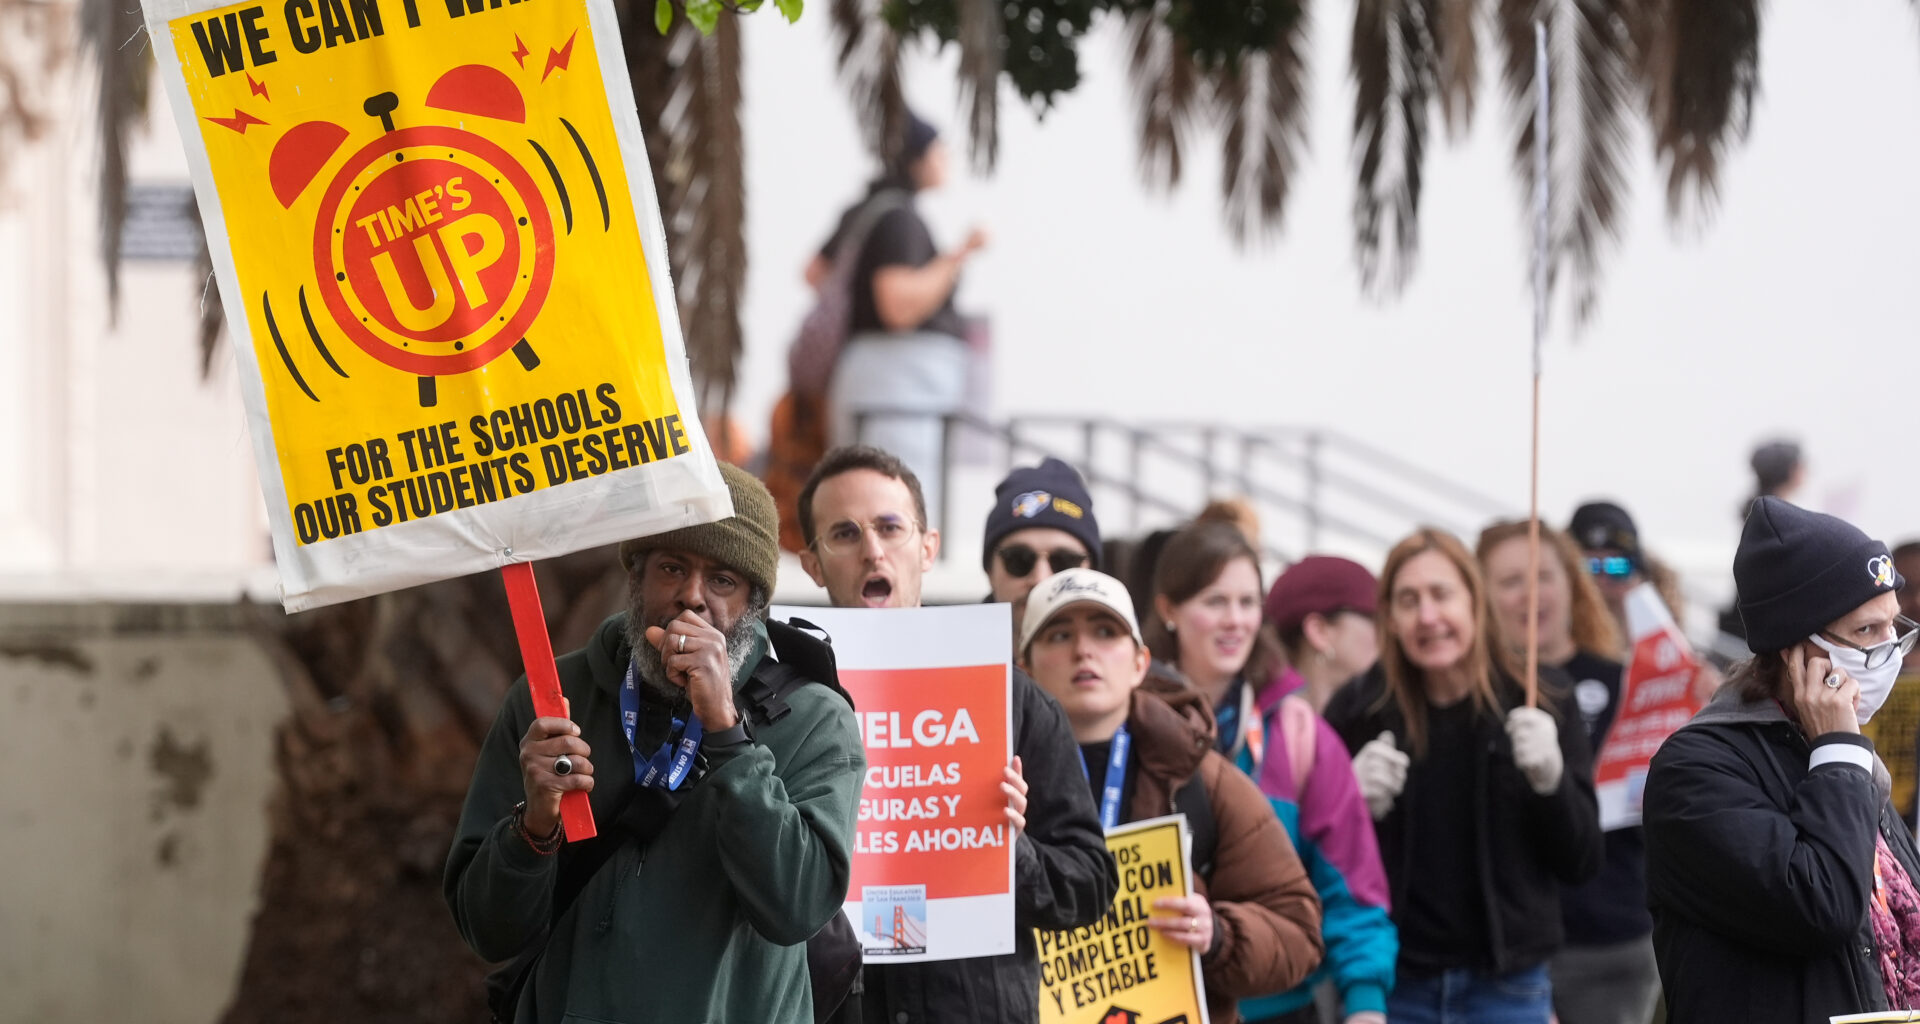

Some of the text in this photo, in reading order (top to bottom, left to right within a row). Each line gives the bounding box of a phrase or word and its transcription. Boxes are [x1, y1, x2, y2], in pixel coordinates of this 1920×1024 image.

[191, 6, 277, 78] WE
[355, 177, 472, 248] TIME'S
[370, 213, 506, 332] UP
[326, 383, 622, 490] FOR THE SCHOOLS
[294, 415, 689, 545] OUR STUDENTS DESERVE
[855, 709, 980, 749] ELGA
[863, 763, 961, 789] CUELAS
[858, 794, 962, 822] GURAS Y
[903, 824, 1004, 853] AHORA!
[1124, 861, 1174, 894] CON
[1040, 925, 1150, 989] COMPLETO
[1050, 952, 1159, 1015] Y ESTABLE
